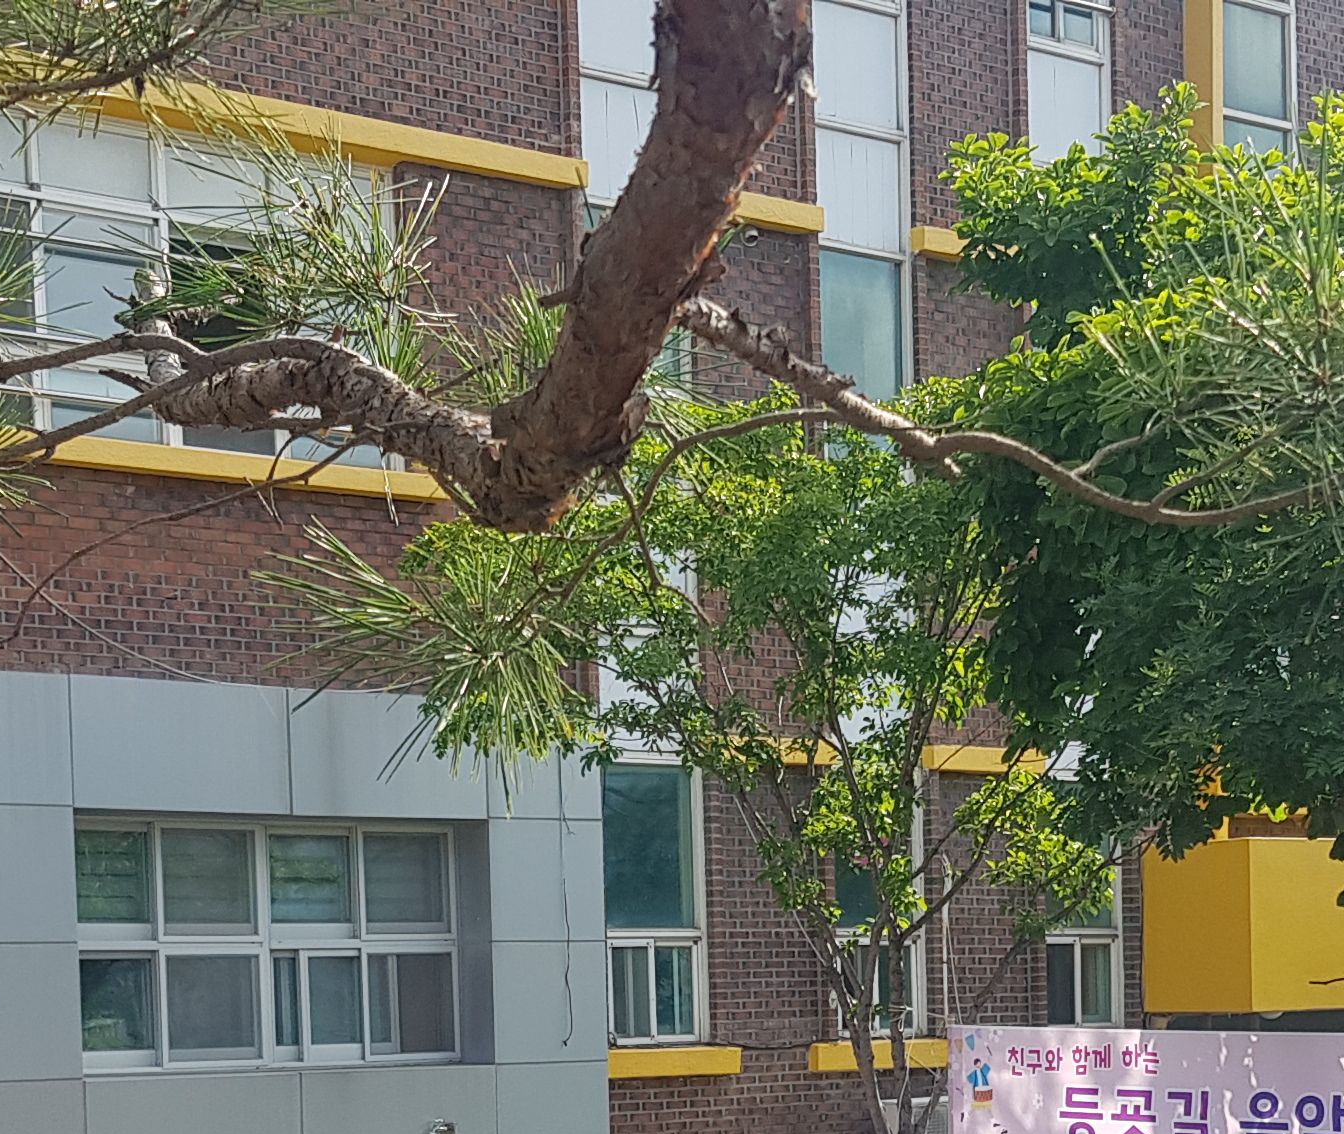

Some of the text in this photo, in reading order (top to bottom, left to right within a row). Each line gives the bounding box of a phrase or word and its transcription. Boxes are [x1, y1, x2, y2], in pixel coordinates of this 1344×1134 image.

[1007, 1043, 1160, 1077] 친구와 함께 하는
